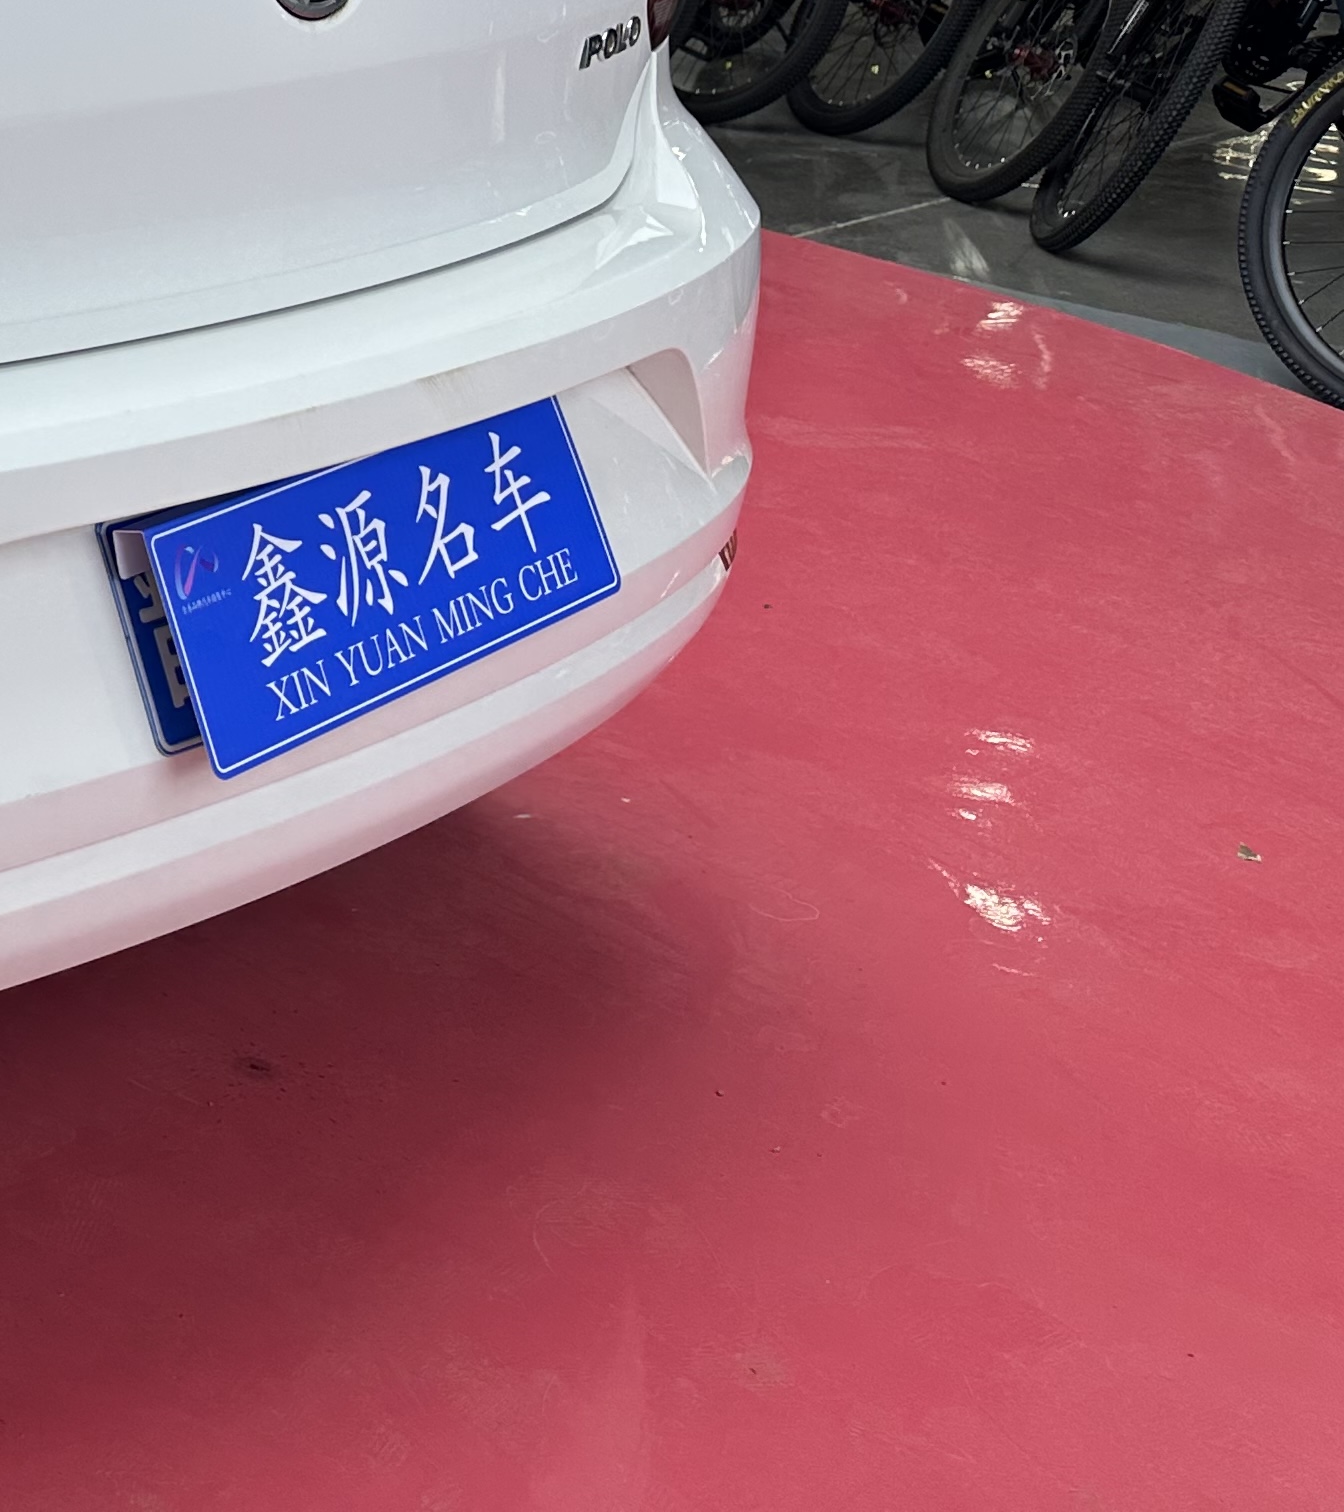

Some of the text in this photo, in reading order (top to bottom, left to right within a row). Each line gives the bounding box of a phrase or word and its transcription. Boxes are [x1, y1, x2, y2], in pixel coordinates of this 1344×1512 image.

[578, 15, 642, 71] POLO
[241, 430, 551, 668] 鑫源名车
[265, 547, 579, 721] XIN YUAN MING CHE
